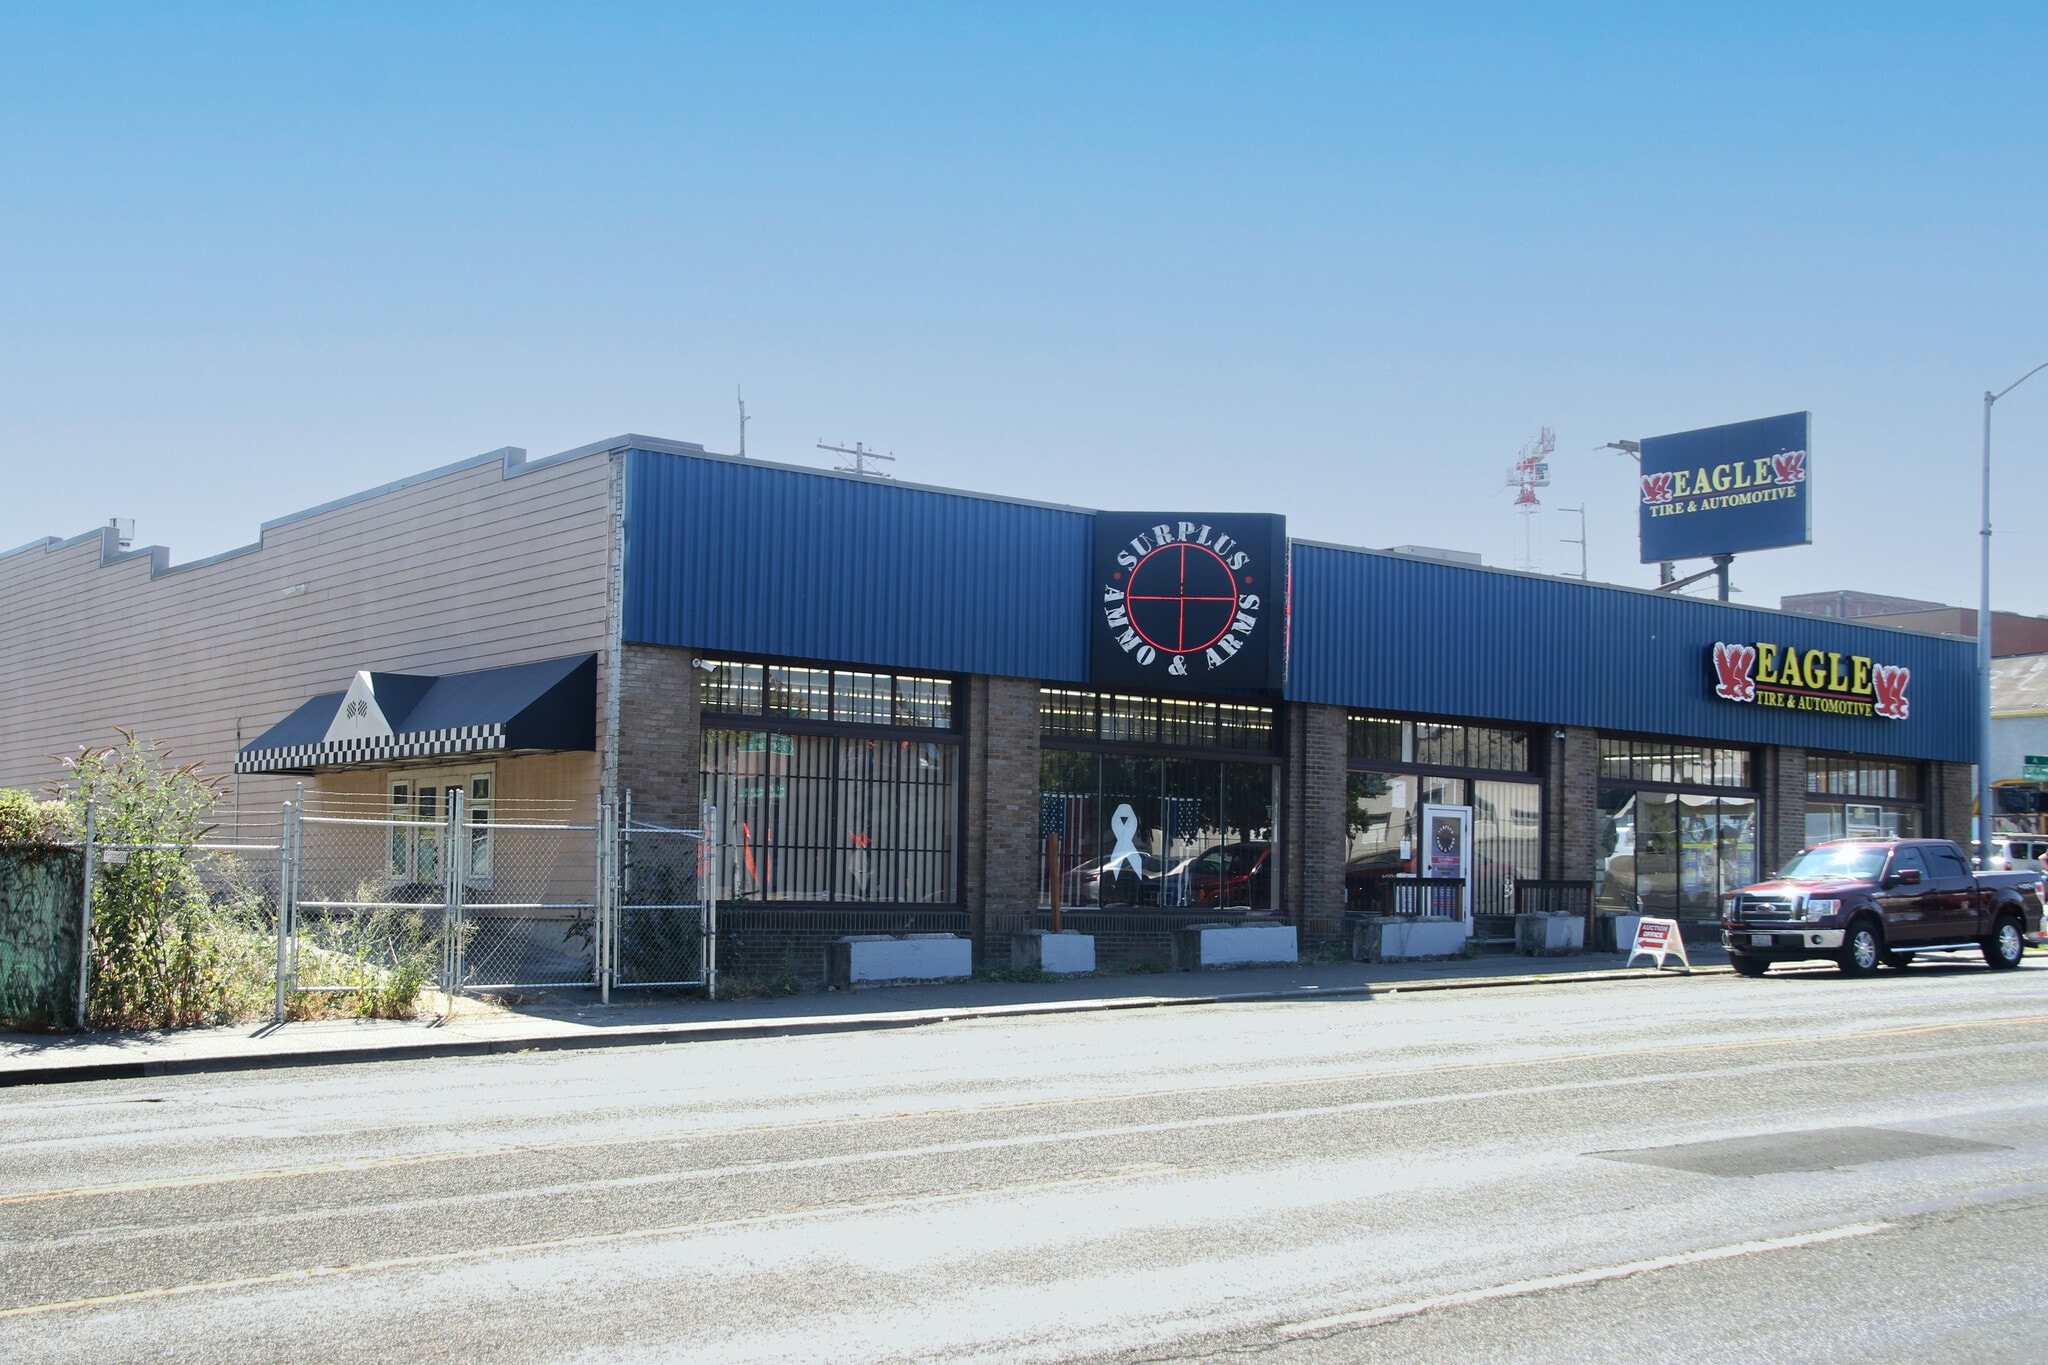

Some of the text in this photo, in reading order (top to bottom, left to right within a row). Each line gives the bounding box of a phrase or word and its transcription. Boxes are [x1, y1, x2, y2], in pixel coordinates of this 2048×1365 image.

[1672, 457, 1773, 498] EAGLE
[1650, 485, 1797, 518] TIRE & AUTOMOTIVE
[1116, 520, 1250, 572] SURPLUS
[1103, 584, 1261, 676] AMMO & ARMS
[1755, 641, 1873, 695] EAGLE
[1756, 690, 1873, 717] TIRE & AUTOMOTIVE
[1642, 930, 1665, 938] OFFICE
